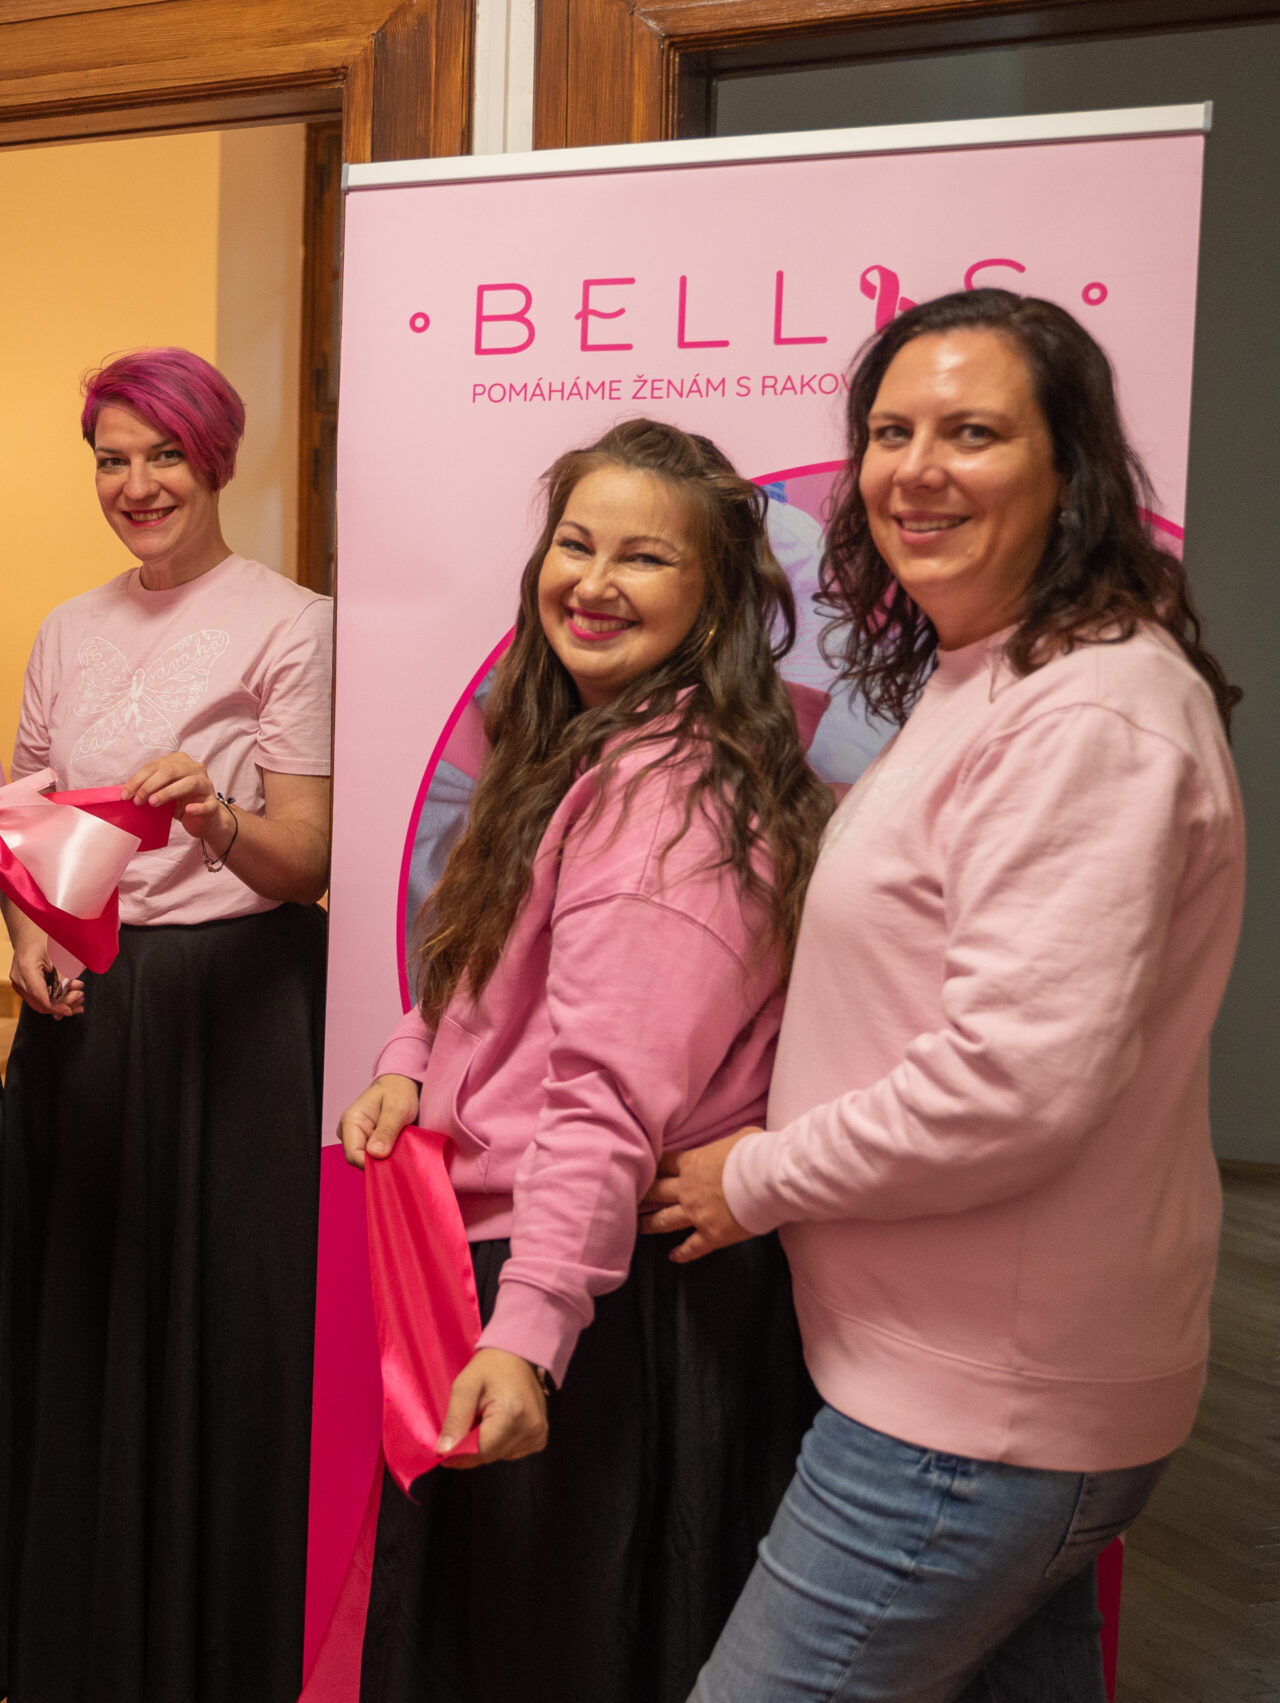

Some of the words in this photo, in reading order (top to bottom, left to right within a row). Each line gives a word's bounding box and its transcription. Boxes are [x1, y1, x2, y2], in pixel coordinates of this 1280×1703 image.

[472, 376, 623, 403] POMÁHÁME
[631, 372, 726, 400] ŽENÁM
[736, 376, 751, 397] S
